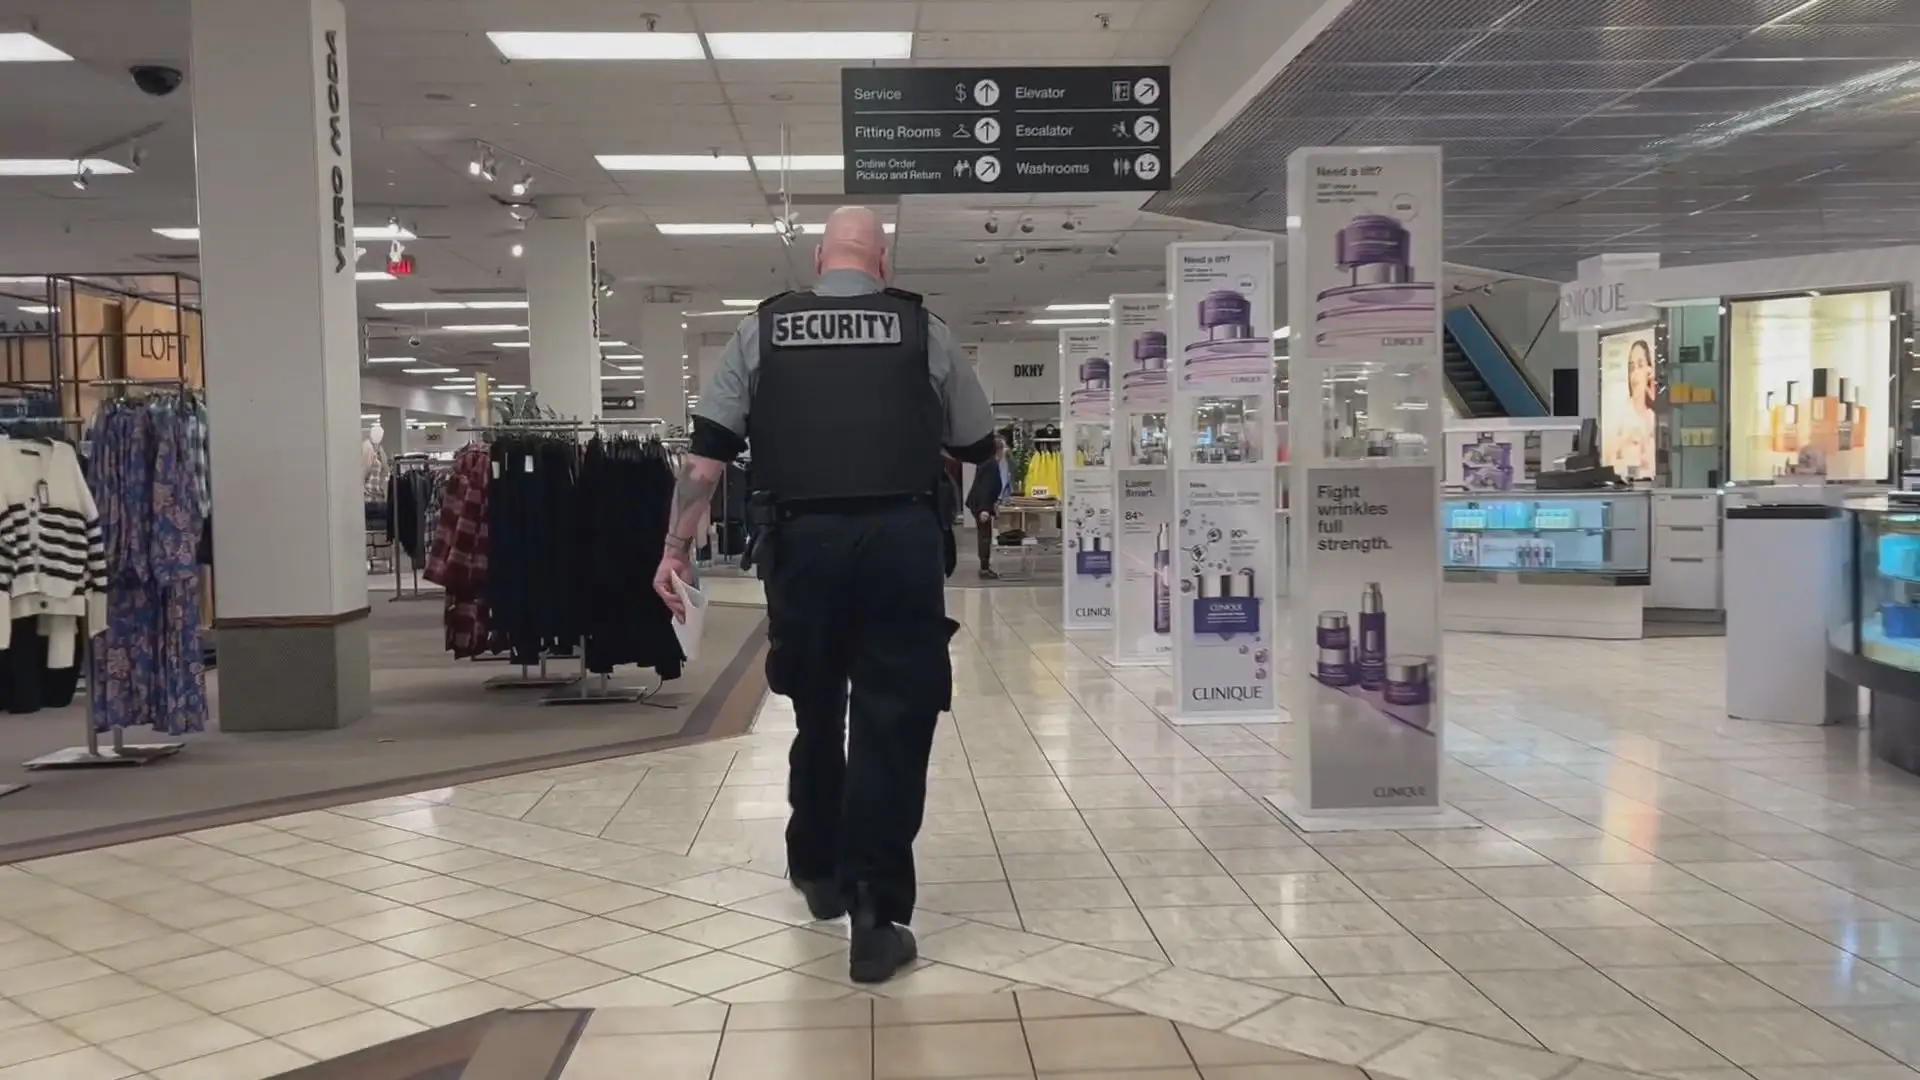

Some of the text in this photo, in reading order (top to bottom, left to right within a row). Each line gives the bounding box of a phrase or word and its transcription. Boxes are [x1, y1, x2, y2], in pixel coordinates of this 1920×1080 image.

[854, 88, 902, 100] Service
[1015, 87, 1065, 99] Elevator
[855, 126, 941, 139] Fitting Rooms
[1015, 125, 1074, 137] Escalator
[325, 30, 346, 273] VERO MODA
[855, 159, 916, 168] Online Order
[1016, 163, 1090, 174] Washrooms
[1139, 161, 1157, 173] L2
[856, 169, 941, 180] Pickup and Return
[1317, 166, 1347, 176] Need
[775, 313, 894, 341] SECURITY
[1014, 363, 1045, 377] DKNY
[1317, 485, 1361, 502] Fight
[1317, 501, 1389, 516] wrinkles
[1318, 519, 1343, 533] full
[1317, 537, 1393, 554] strength.
[1192, 685, 1264, 701] CLINIQUE
[1373, 785, 1428, 799] CLINIQUE
